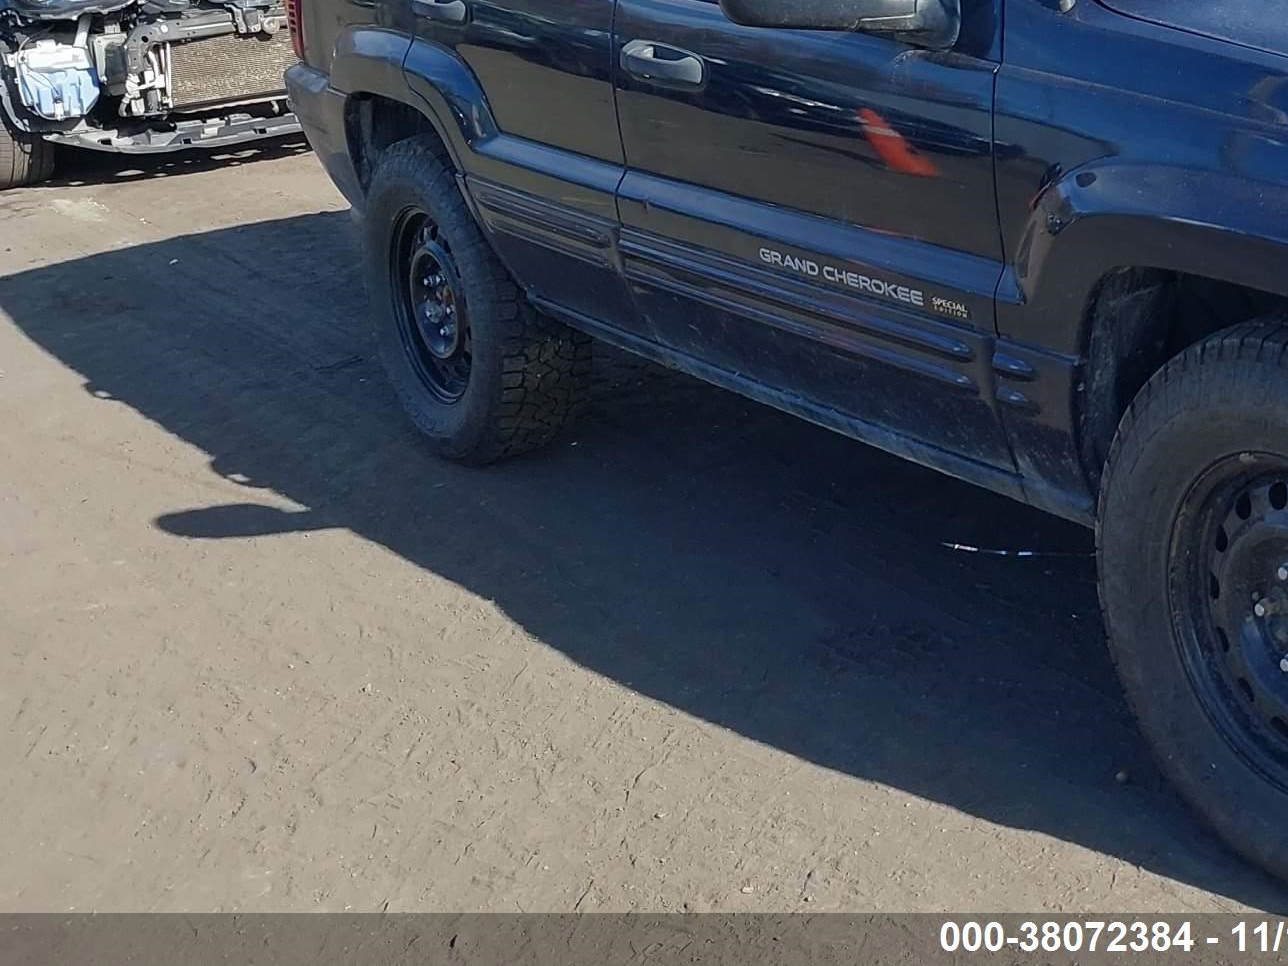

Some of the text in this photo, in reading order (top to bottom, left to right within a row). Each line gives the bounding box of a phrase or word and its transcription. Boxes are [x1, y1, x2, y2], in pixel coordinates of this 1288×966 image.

[759, 248, 924, 306] GRAND CHEROKEE
[931, 296, 968, 313] SPECIAL
